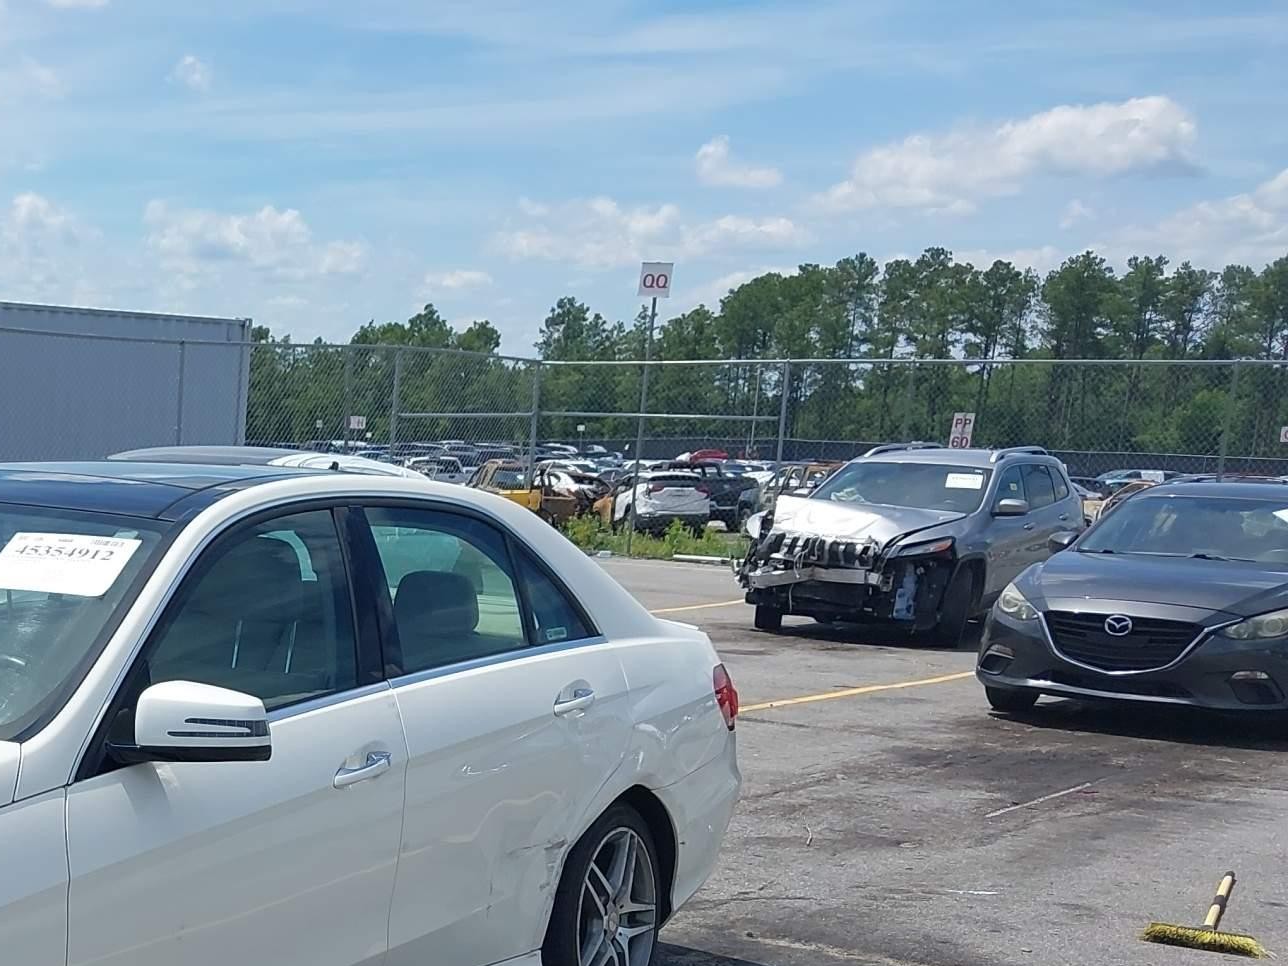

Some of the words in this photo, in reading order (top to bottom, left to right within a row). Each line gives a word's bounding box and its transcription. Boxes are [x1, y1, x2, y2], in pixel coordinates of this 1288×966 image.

[643, 273, 668, 289] QQ
[955, 417, 972, 429] PP
[951, 436, 969, 448] 60
[15, 545, 115, 561] 45354912
